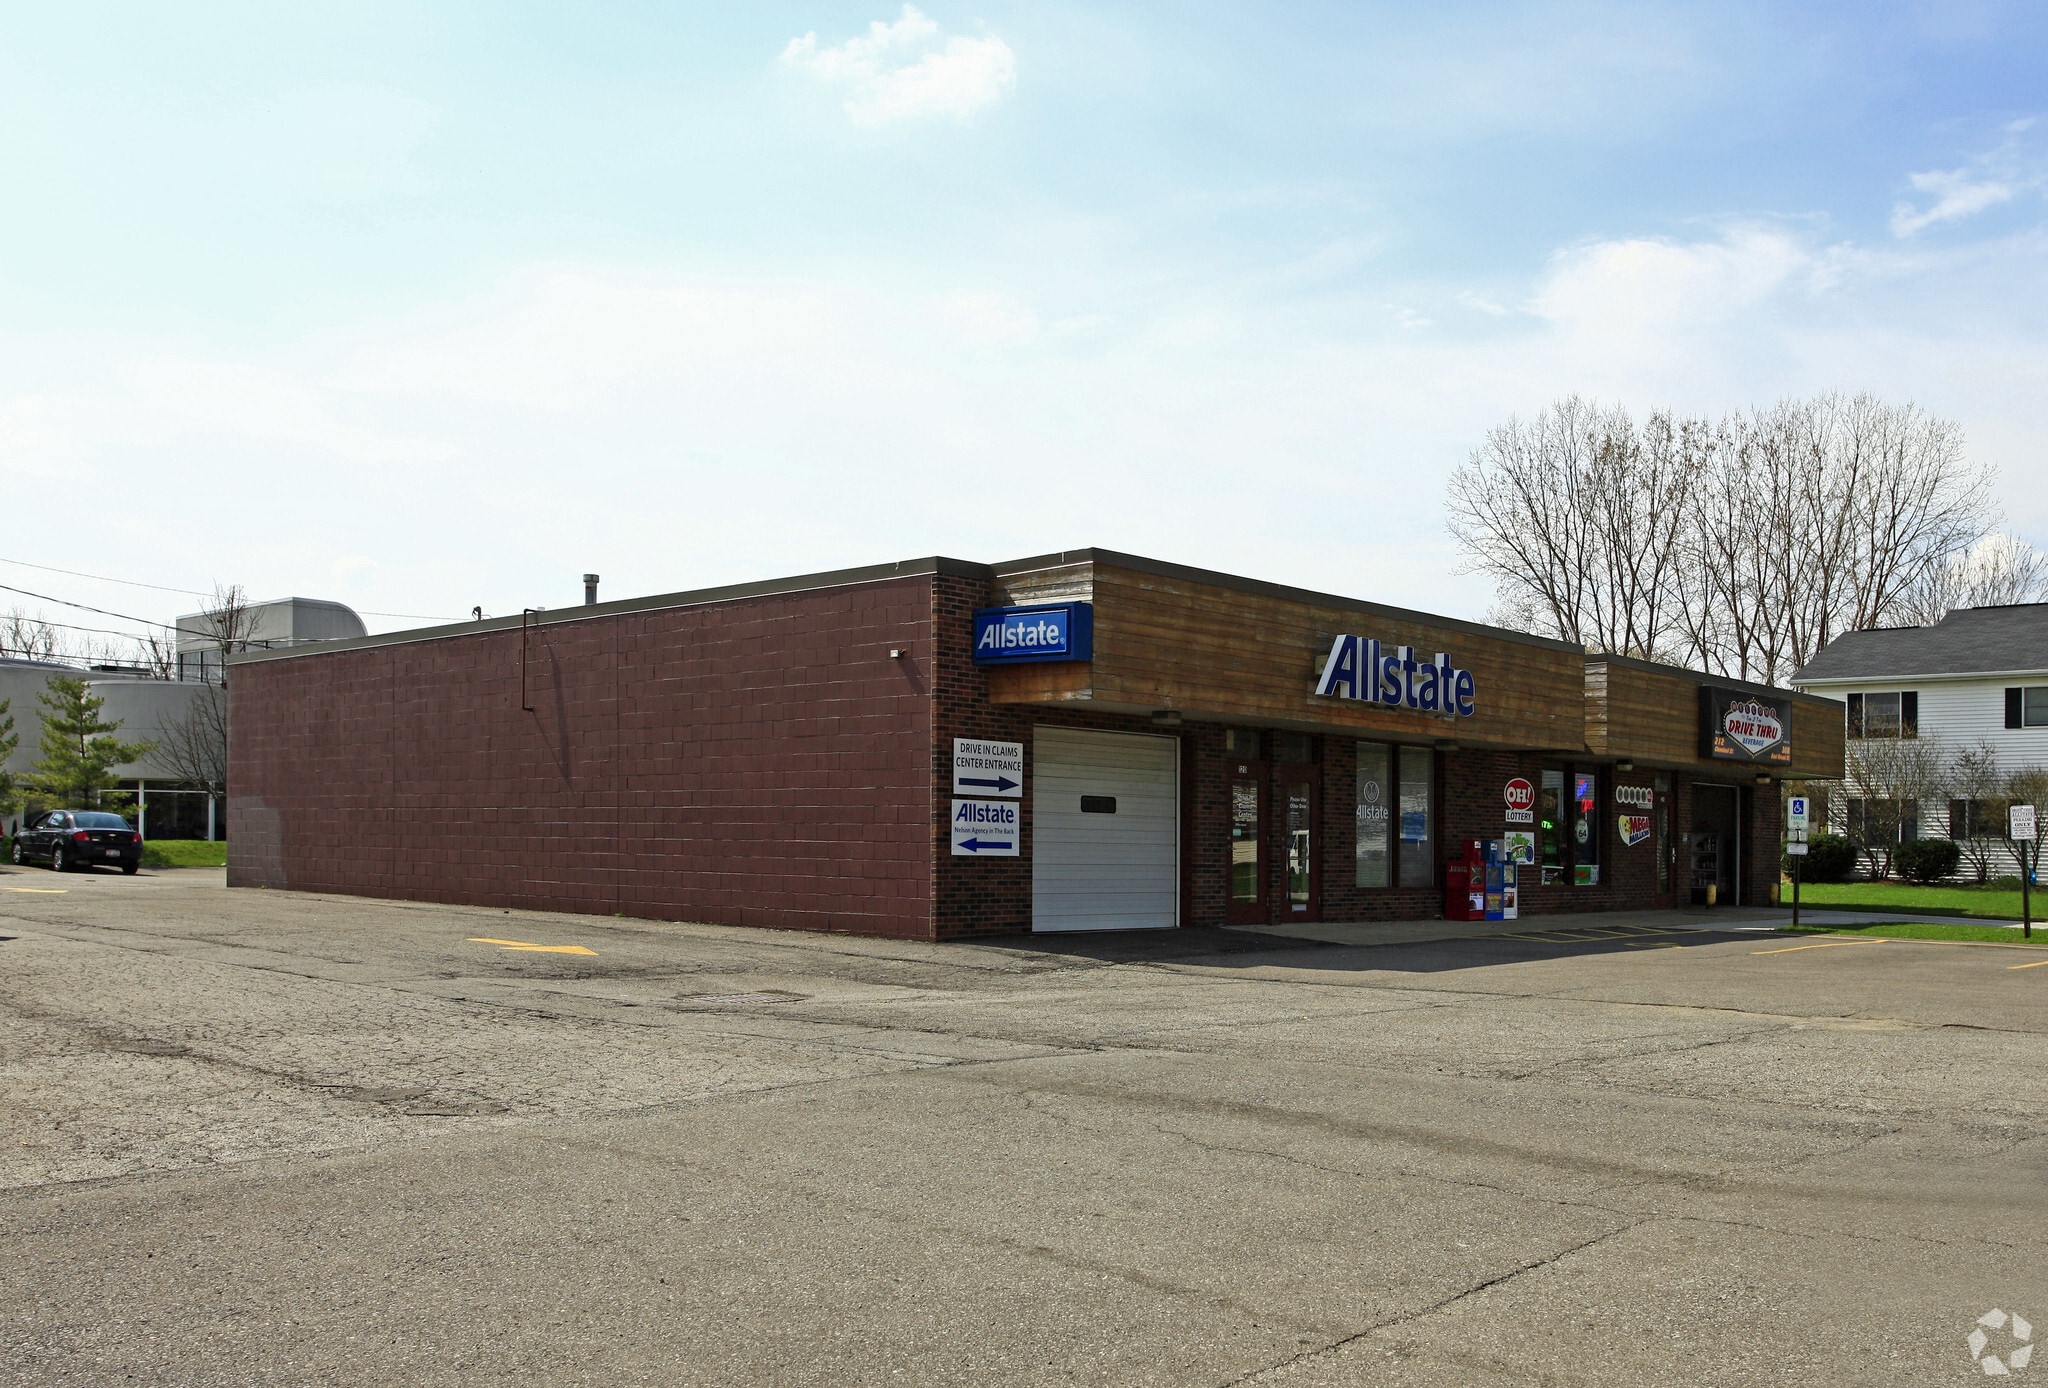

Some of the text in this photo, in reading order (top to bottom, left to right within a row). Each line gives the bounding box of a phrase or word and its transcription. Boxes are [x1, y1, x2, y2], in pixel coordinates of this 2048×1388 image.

[978, 620, 1060, 650] Allstate
[1315, 634, 1475, 718] Allstate
[1728, 719, 1778, 740] DRIVE THRU
[1714, 736, 1725, 745] 212
[1742, 737, 1765, 747] BEVERAGE
[960, 742, 1018, 758] DRIVE IN CLAIMS
[956, 757, 1021, 772] CENTER ENTRANCE
[1506, 786, 1531, 803] OH!
[956, 803, 1014, 823] Allstate
[1356, 804, 1389, 819] Allstate
[1507, 812, 1532, 820] LOTTERY
[971, 827, 988, 835] Agency
[1629, 817, 1649, 834] MEGA
